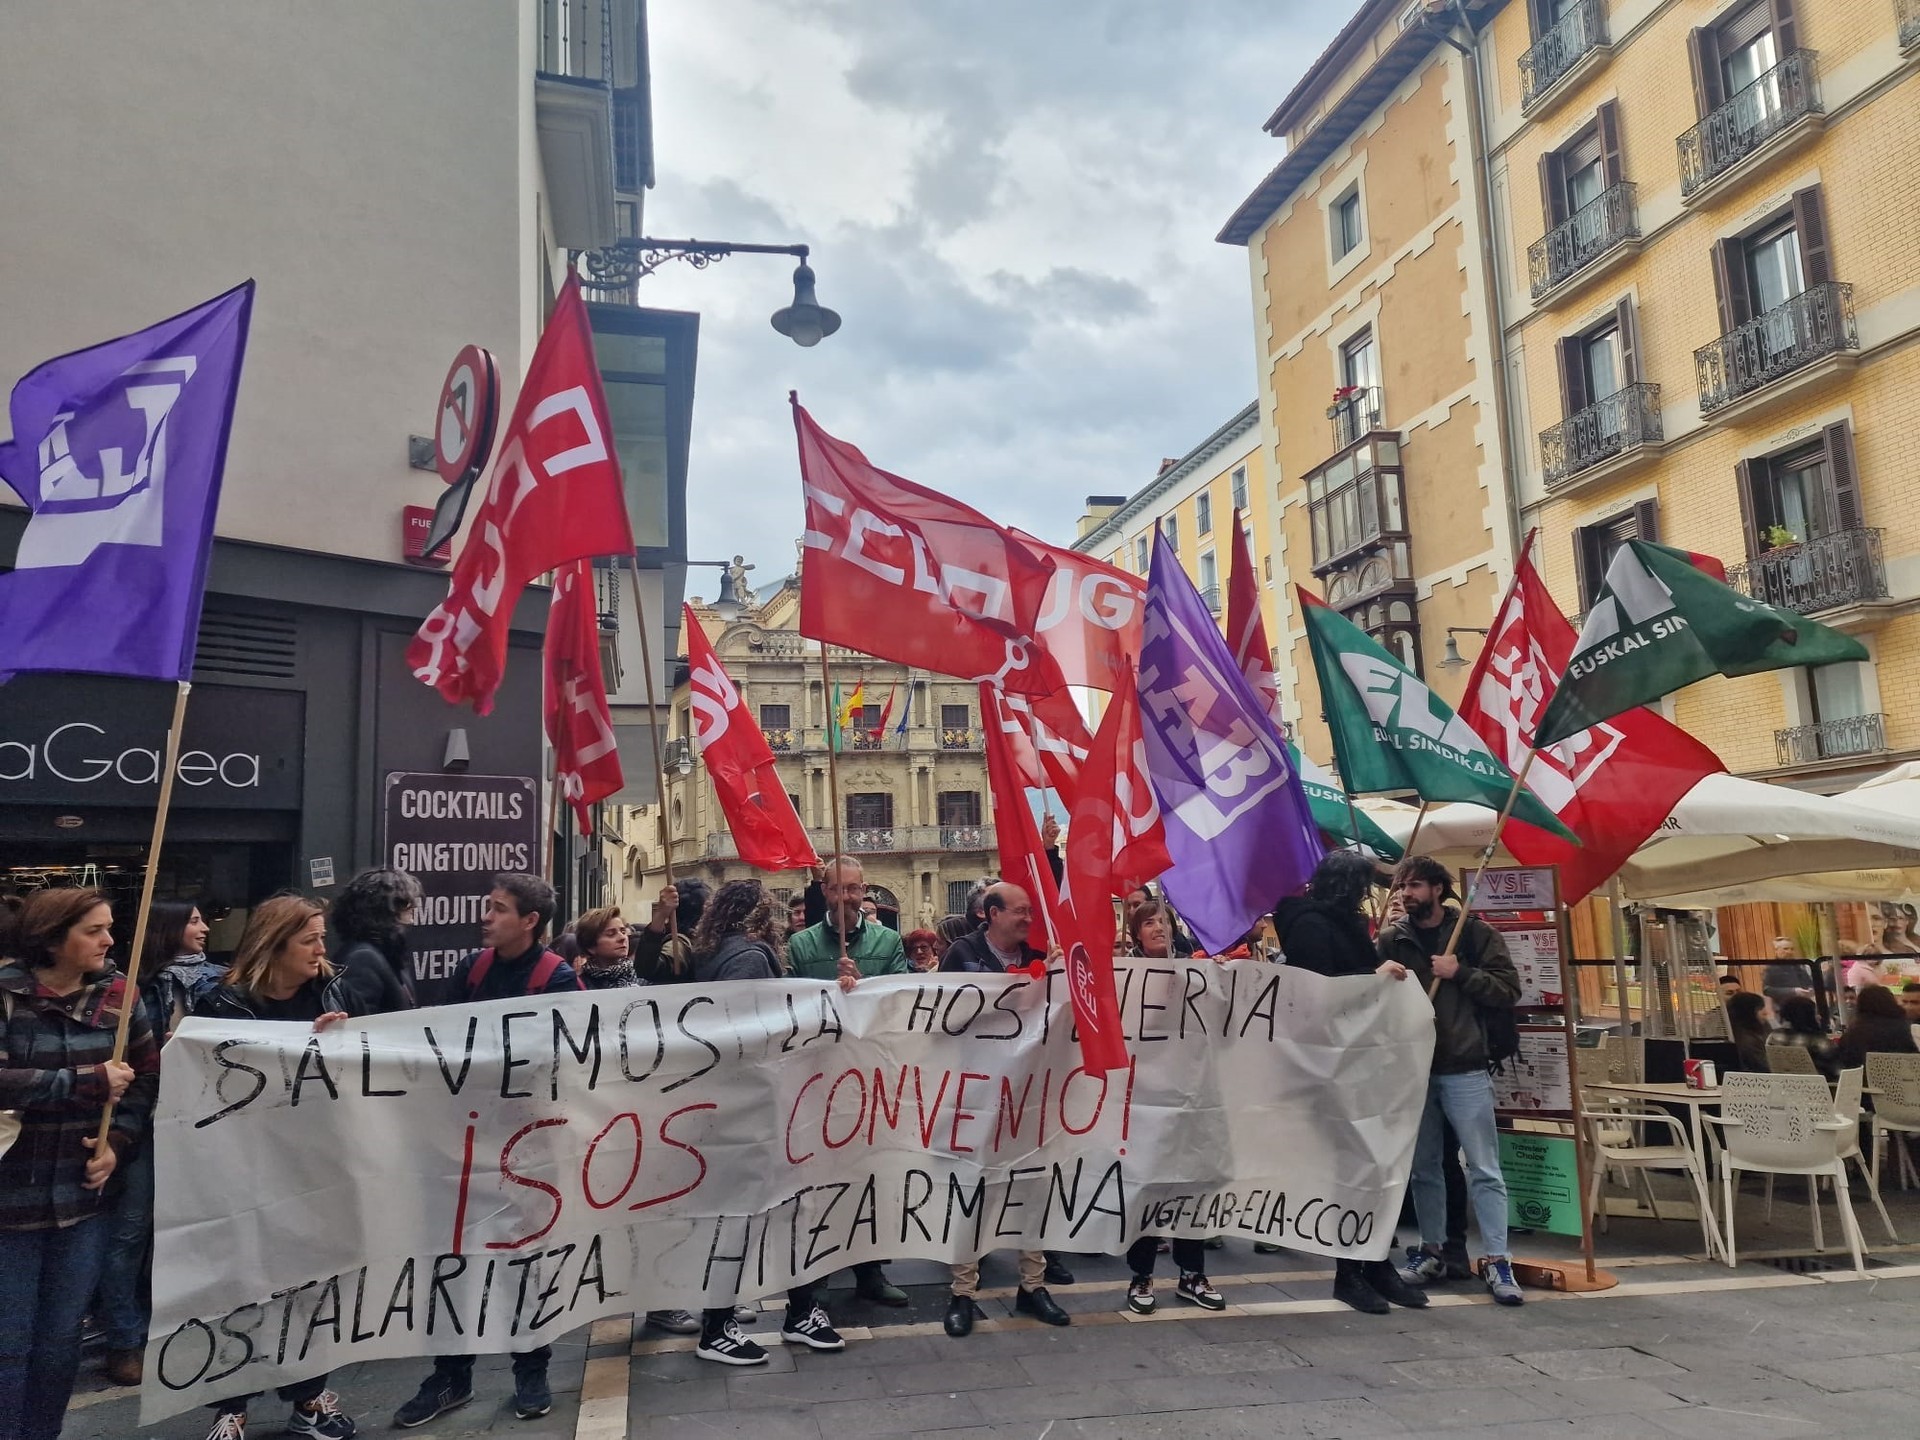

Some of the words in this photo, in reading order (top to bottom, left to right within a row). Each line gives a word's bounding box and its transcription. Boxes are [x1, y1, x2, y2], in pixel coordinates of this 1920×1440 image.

[1569, 632, 1650, 681] EUSKAL
[401, 789, 523, 820] COCKTAILS
[393, 843, 528, 872] GIN&TONICS
[1485, 872, 1535, 893] VSF
[1533, 932, 1557, 947] VSF
[195, 996, 721, 1128] SALVEMOS
[786, 1054, 1136, 1165] CONVENIO!
[702, 1157, 1126, 1295] HITZARMENA
[157, 1235, 606, 1391] OSTALARITZA
